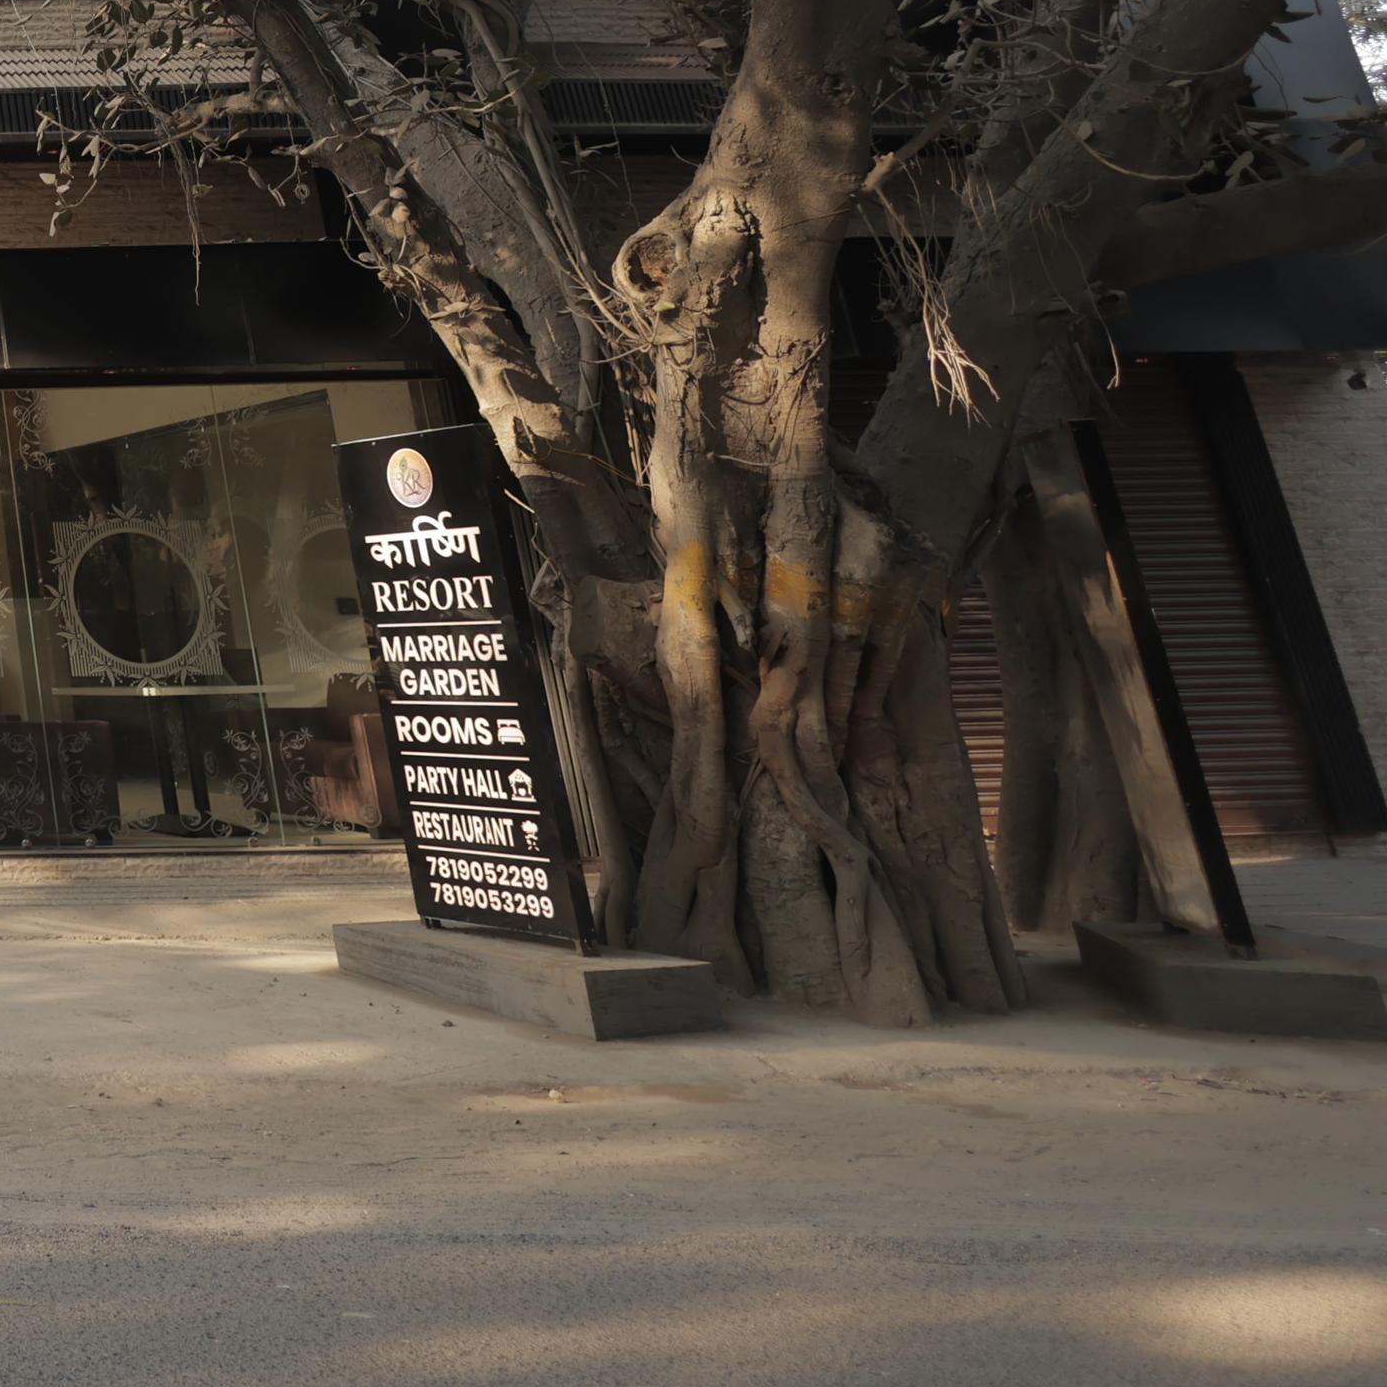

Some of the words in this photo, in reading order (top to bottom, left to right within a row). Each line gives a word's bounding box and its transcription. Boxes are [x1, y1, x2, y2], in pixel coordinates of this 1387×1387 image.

[364, 511, 481, 569] कार्ष्णि
[371, 575, 494, 613] RESORT
[380, 633, 508, 662] MARRIAGE
[399, 668, 501, 697] GARDEN
[394, 715, 493, 746] ROOMS
[403, 765, 459, 796] PARTY
[461, 768, 508, 800] HALL
[412, 811, 515, 847] RESTAURANT
[426, 856, 549, 891] 7819052299
[430, 882, 555, 919] 7819053299
